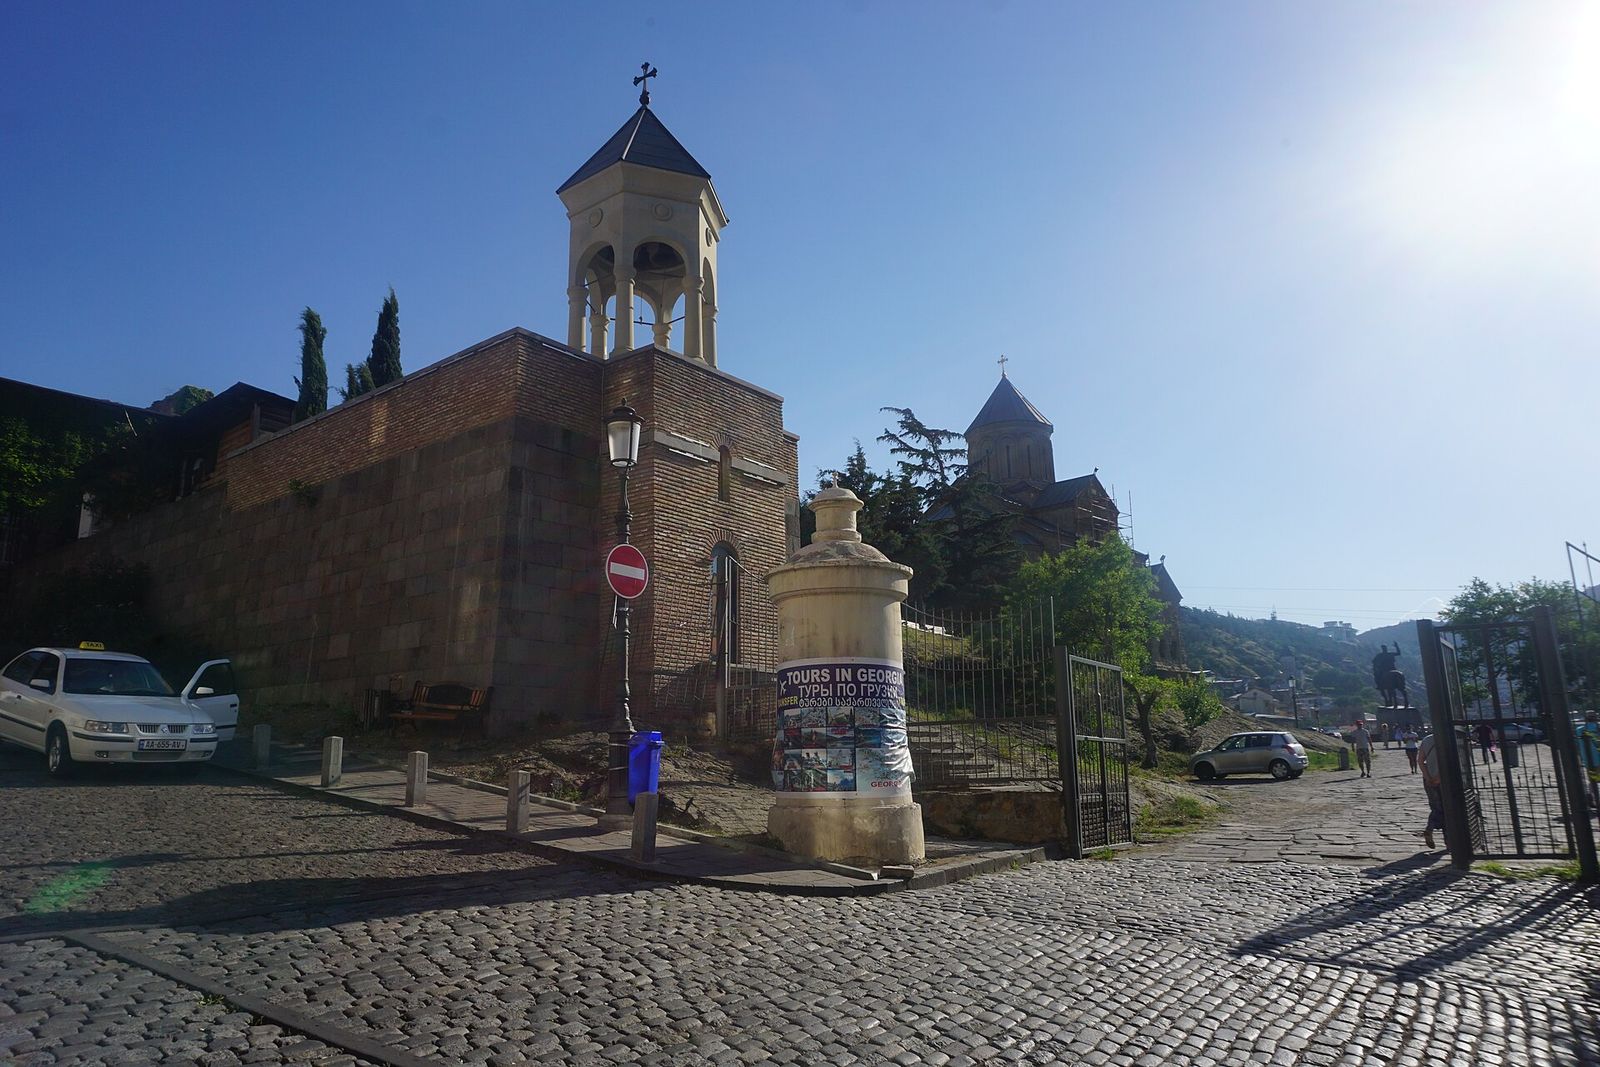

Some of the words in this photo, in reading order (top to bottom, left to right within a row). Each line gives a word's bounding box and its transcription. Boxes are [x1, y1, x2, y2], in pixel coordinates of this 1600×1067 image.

[787, 669, 830, 685] TOURS
[835, 668, 852, 682] IN
[798, 684, 833, 698] ТУРЫ
[837, 683, 857, 697] ПО
[145, 740, 181, 749] AA-655-AV
